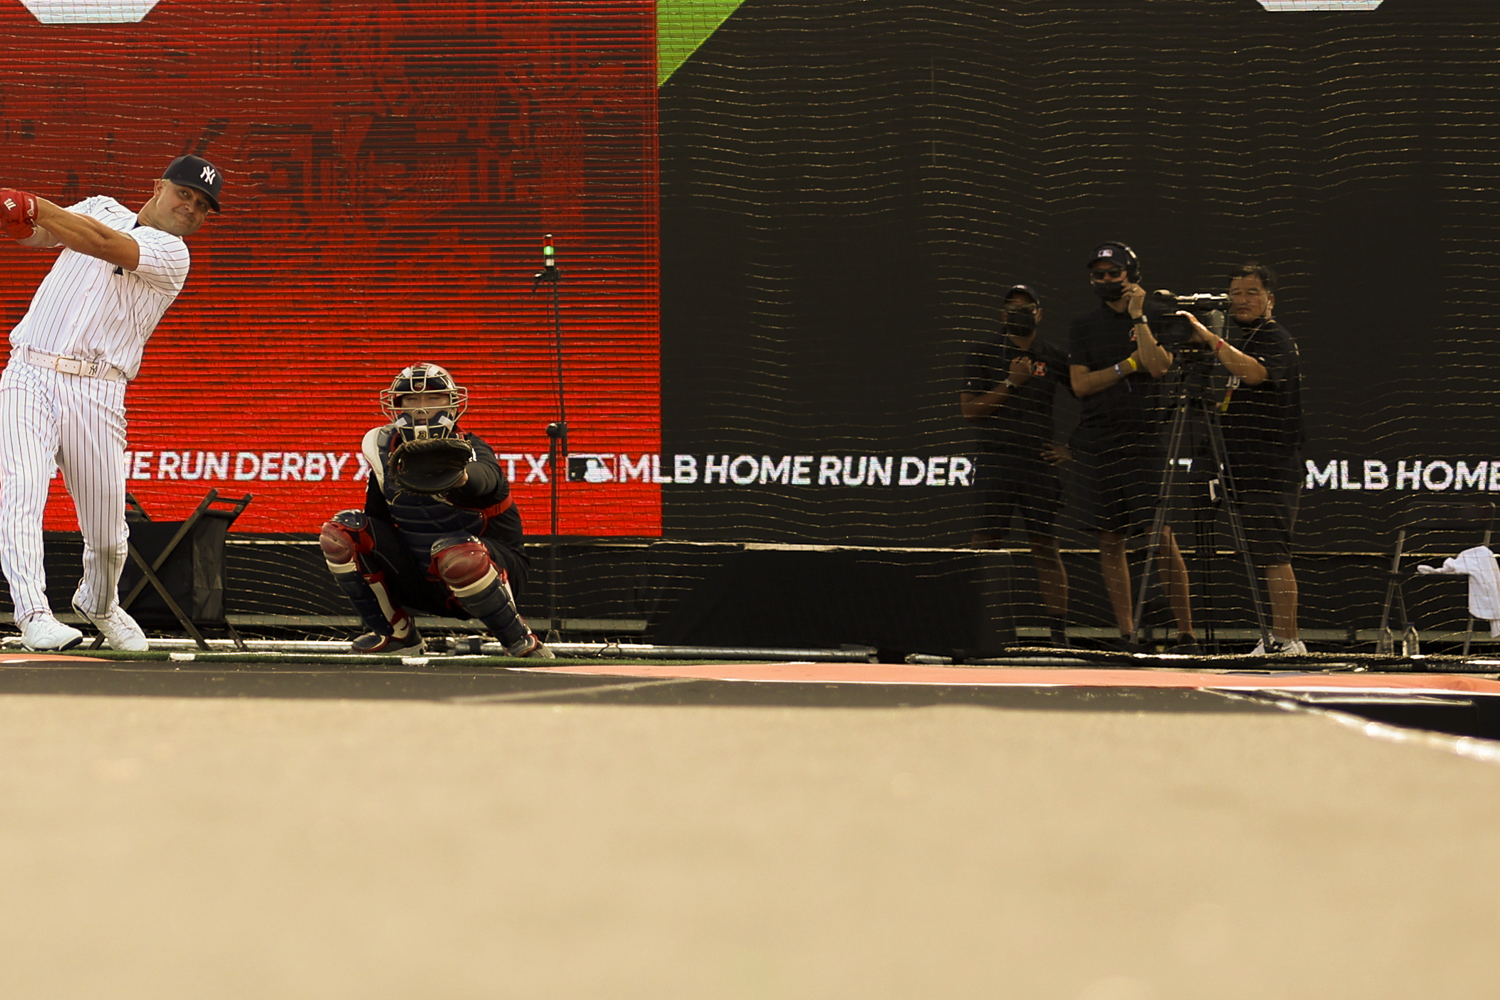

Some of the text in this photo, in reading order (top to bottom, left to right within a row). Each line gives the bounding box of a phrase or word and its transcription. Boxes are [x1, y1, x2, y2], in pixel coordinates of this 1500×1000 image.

[157, 451, 230, 480] RUN
[233, 451, 351, 481] DERBY
[495, 453, 549, 483] TX
[619, 454, 976, 486] MLB HOME RUN DER
[1305, 459, 1388, 490] MLB
